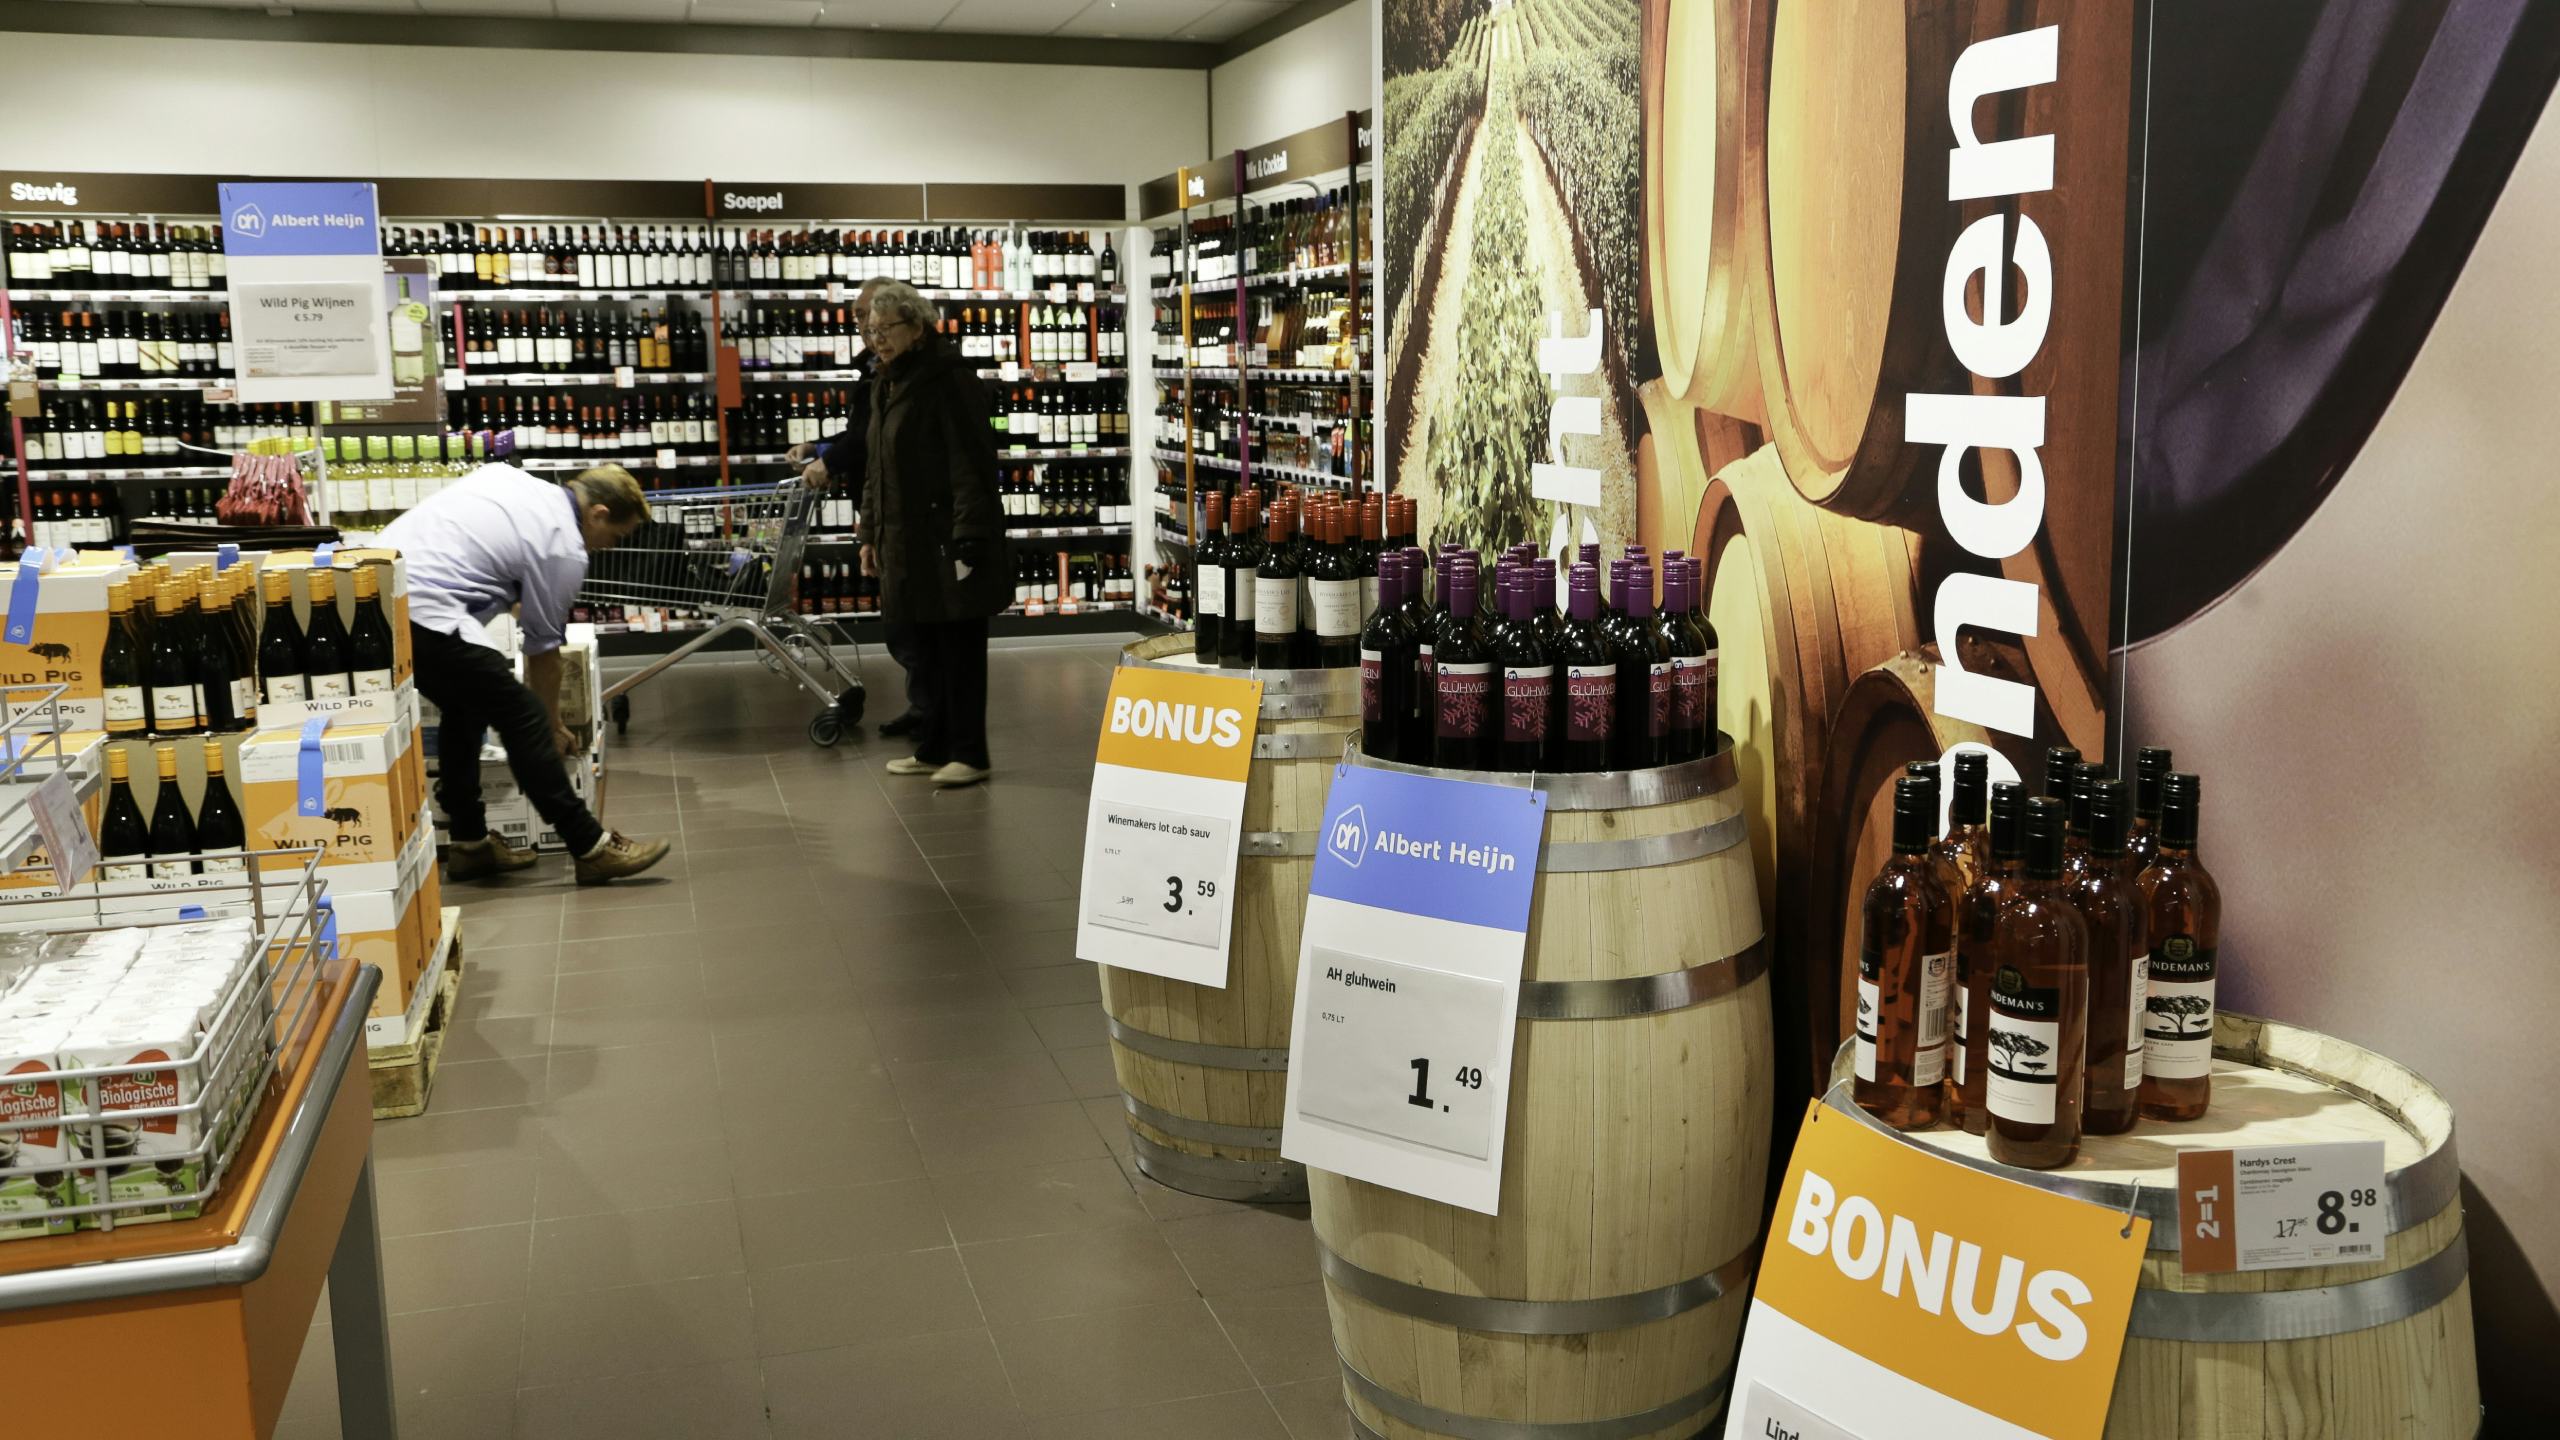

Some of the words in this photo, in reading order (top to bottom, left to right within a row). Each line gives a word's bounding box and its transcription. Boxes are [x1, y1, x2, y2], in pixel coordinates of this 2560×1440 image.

[10, 182, 78, 206] Stevig
[723, 191, 784, 213] Soepel
[271, 214, 320, 227] Albert
[323, 213, 365, 229] Heijn
[259, 297, 288, 308] Wild
[291, 297, 310, 310] Pig
[312, 296, 355, 310] Wijnen
[294, 313, 301, 322] €
[302, 313, 323, 322] 5.79
[45, 670, 82, 683] PIG
[59, 705, 86, 715] PIG
[305, 702, 342, 712] WILD
[348, 699, 374, 709] PIG
[1110, 696, 1243, 748] BONUS
[1107, 813, 1157, 832] Winemakers
[1158, 820, 1170, 834] lot
[1172, 824, 1188, 837] cab
[1190, 828, 1211, 840] sauv
[336, 834, 373, 847] PIG
[1374, 830, 1442, 861] Albert
[1449, 841, 1516, 874] Heijn
[1326, 966, 1343, 983] AH
[1345, 970, 1396, 993] gluhwein
[1322, 1011, 1336, 1023] 0,75
[1336, 1014, 1345, 1024] LT
[100, 1083, 175, 1106] Biologische
[2239, 1157, 2270, 1168] Hardys
[2273, 1156, 2296, 1165] Crest
[2195, 1184, 2220, 1240] 2=1
[1787, 1168, 2093, 1361] BONUS
